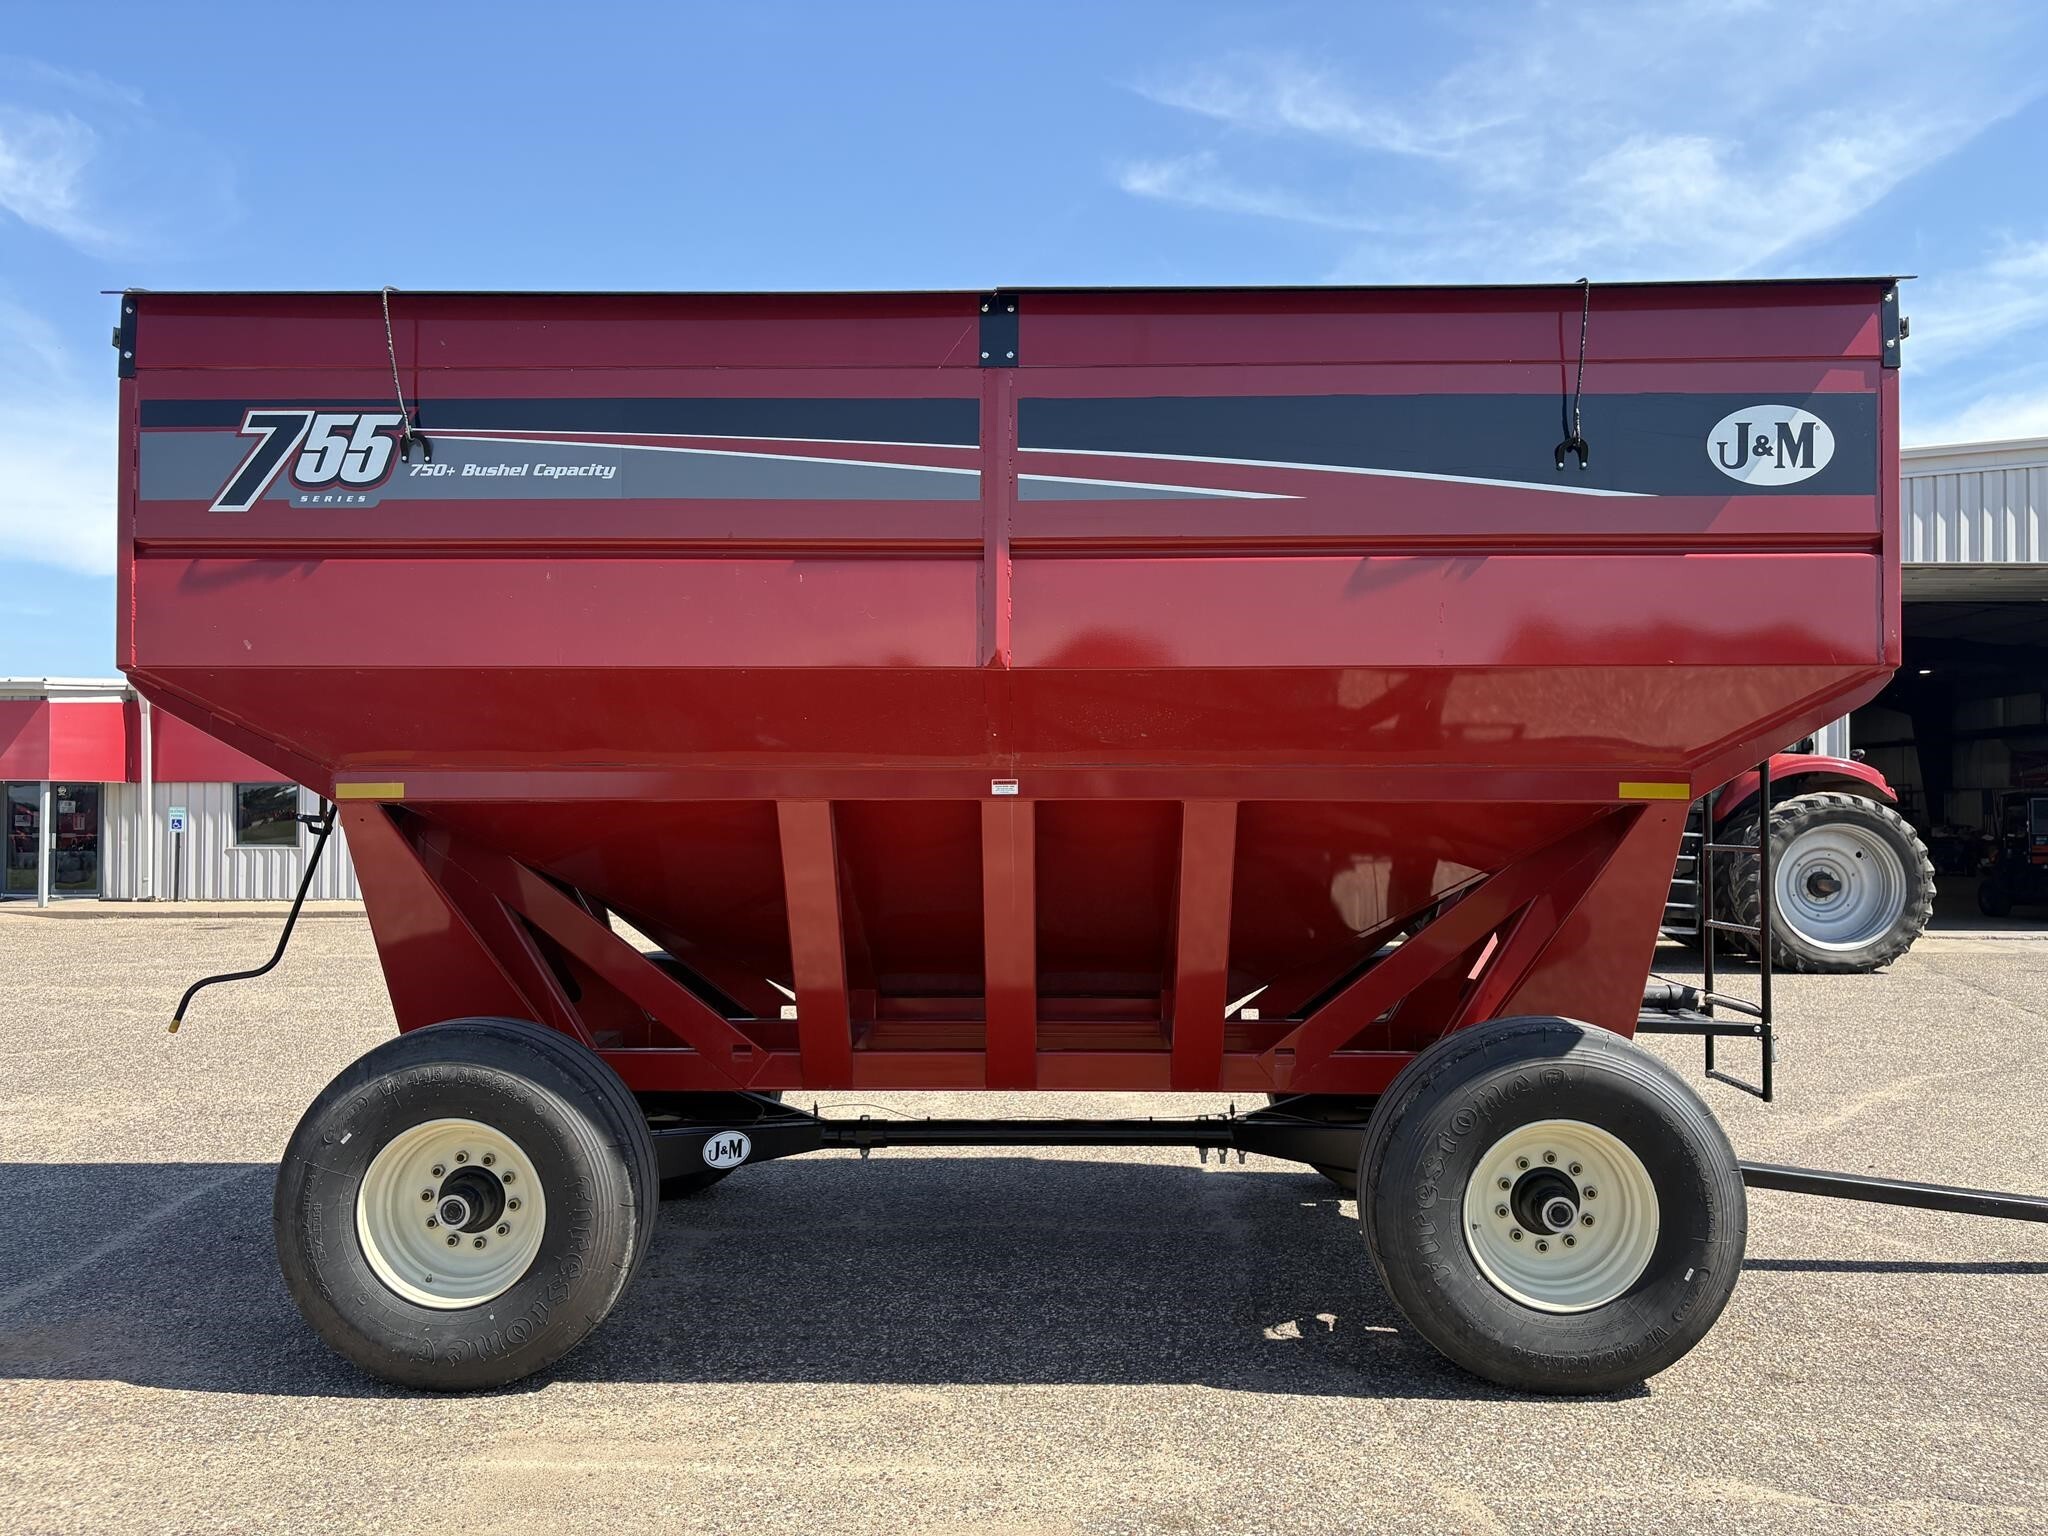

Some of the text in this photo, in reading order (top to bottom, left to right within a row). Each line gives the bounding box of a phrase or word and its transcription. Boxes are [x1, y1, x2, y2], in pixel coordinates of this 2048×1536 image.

[1717, 422, 1817, 469] J&M
[208, 410, 403, 512] 755
[409, 463, 616, 479] 750+ Bushel Capacity
[299, 494, 368, 503] SERIES
[708, 1138, 743, 1161] J&M
